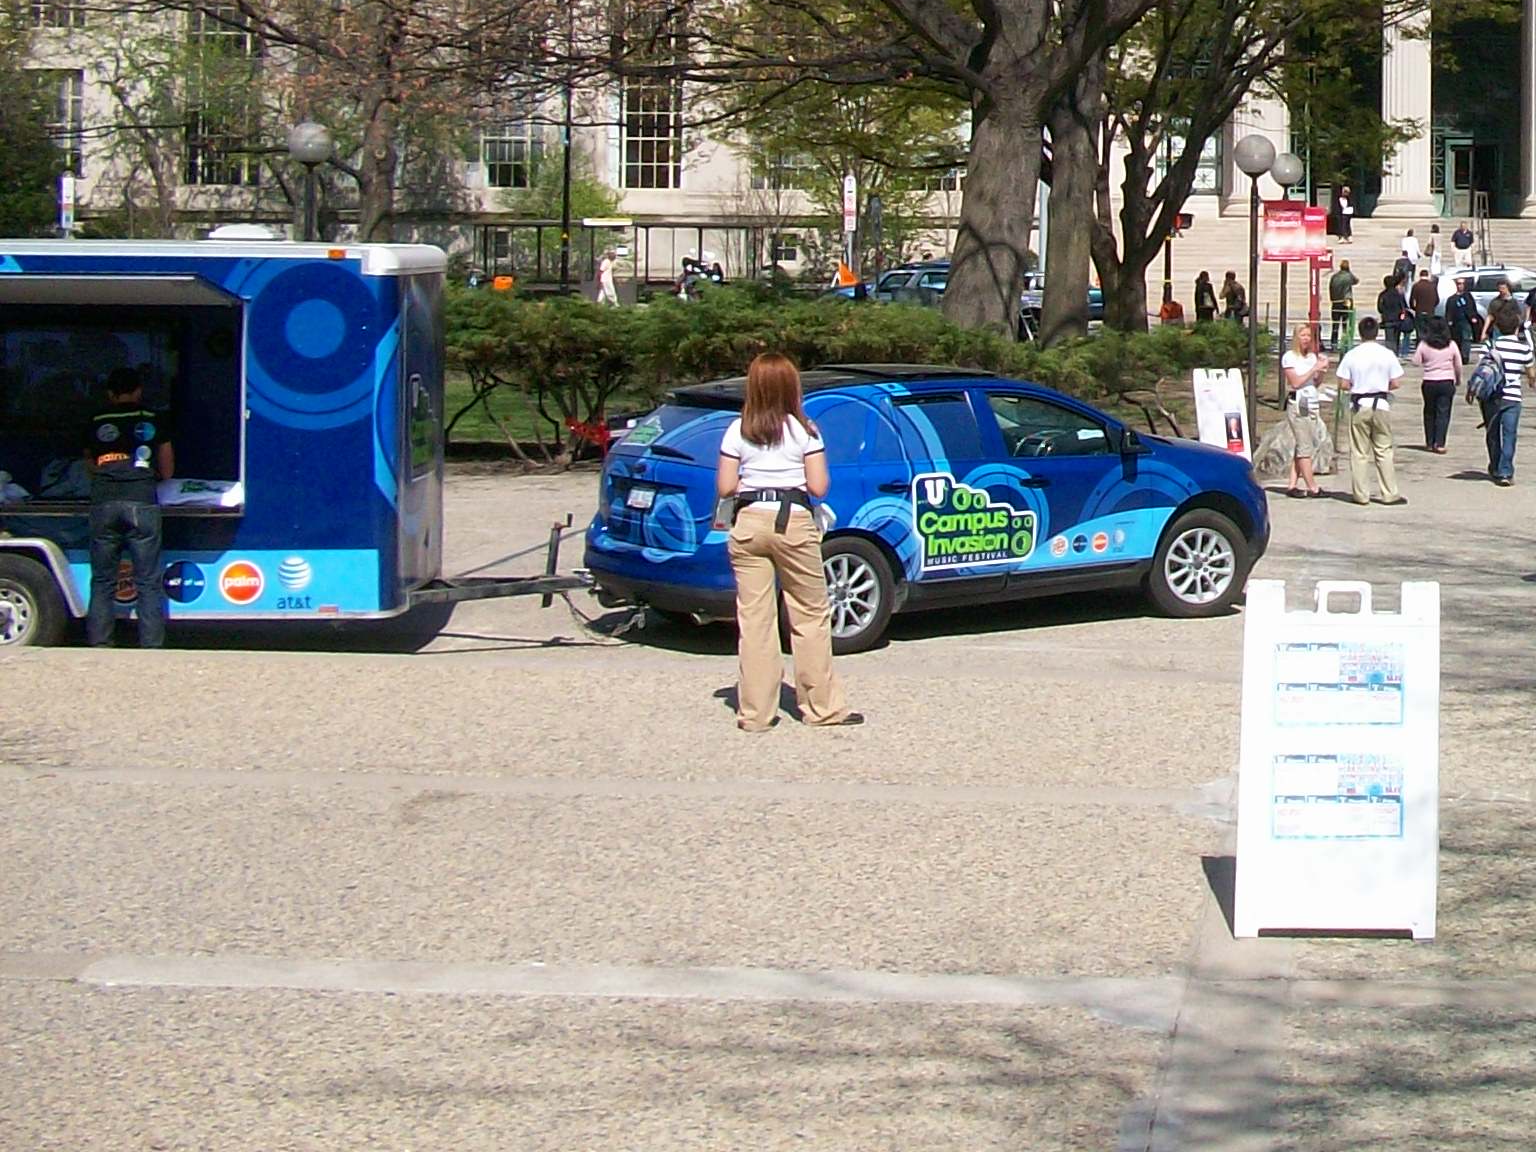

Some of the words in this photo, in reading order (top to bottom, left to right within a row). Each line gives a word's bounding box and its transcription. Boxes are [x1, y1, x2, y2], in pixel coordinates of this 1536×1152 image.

[920, 510, 1009, 534] Campus
[928, 531, 1009, 556] Invasion
[927, 556, 957, 565] MUSIC
[961, 551, 1008, 562] FESTIVAL
[224, 575, 261, 589] palm
[276, 595, 312, 610] at&t
